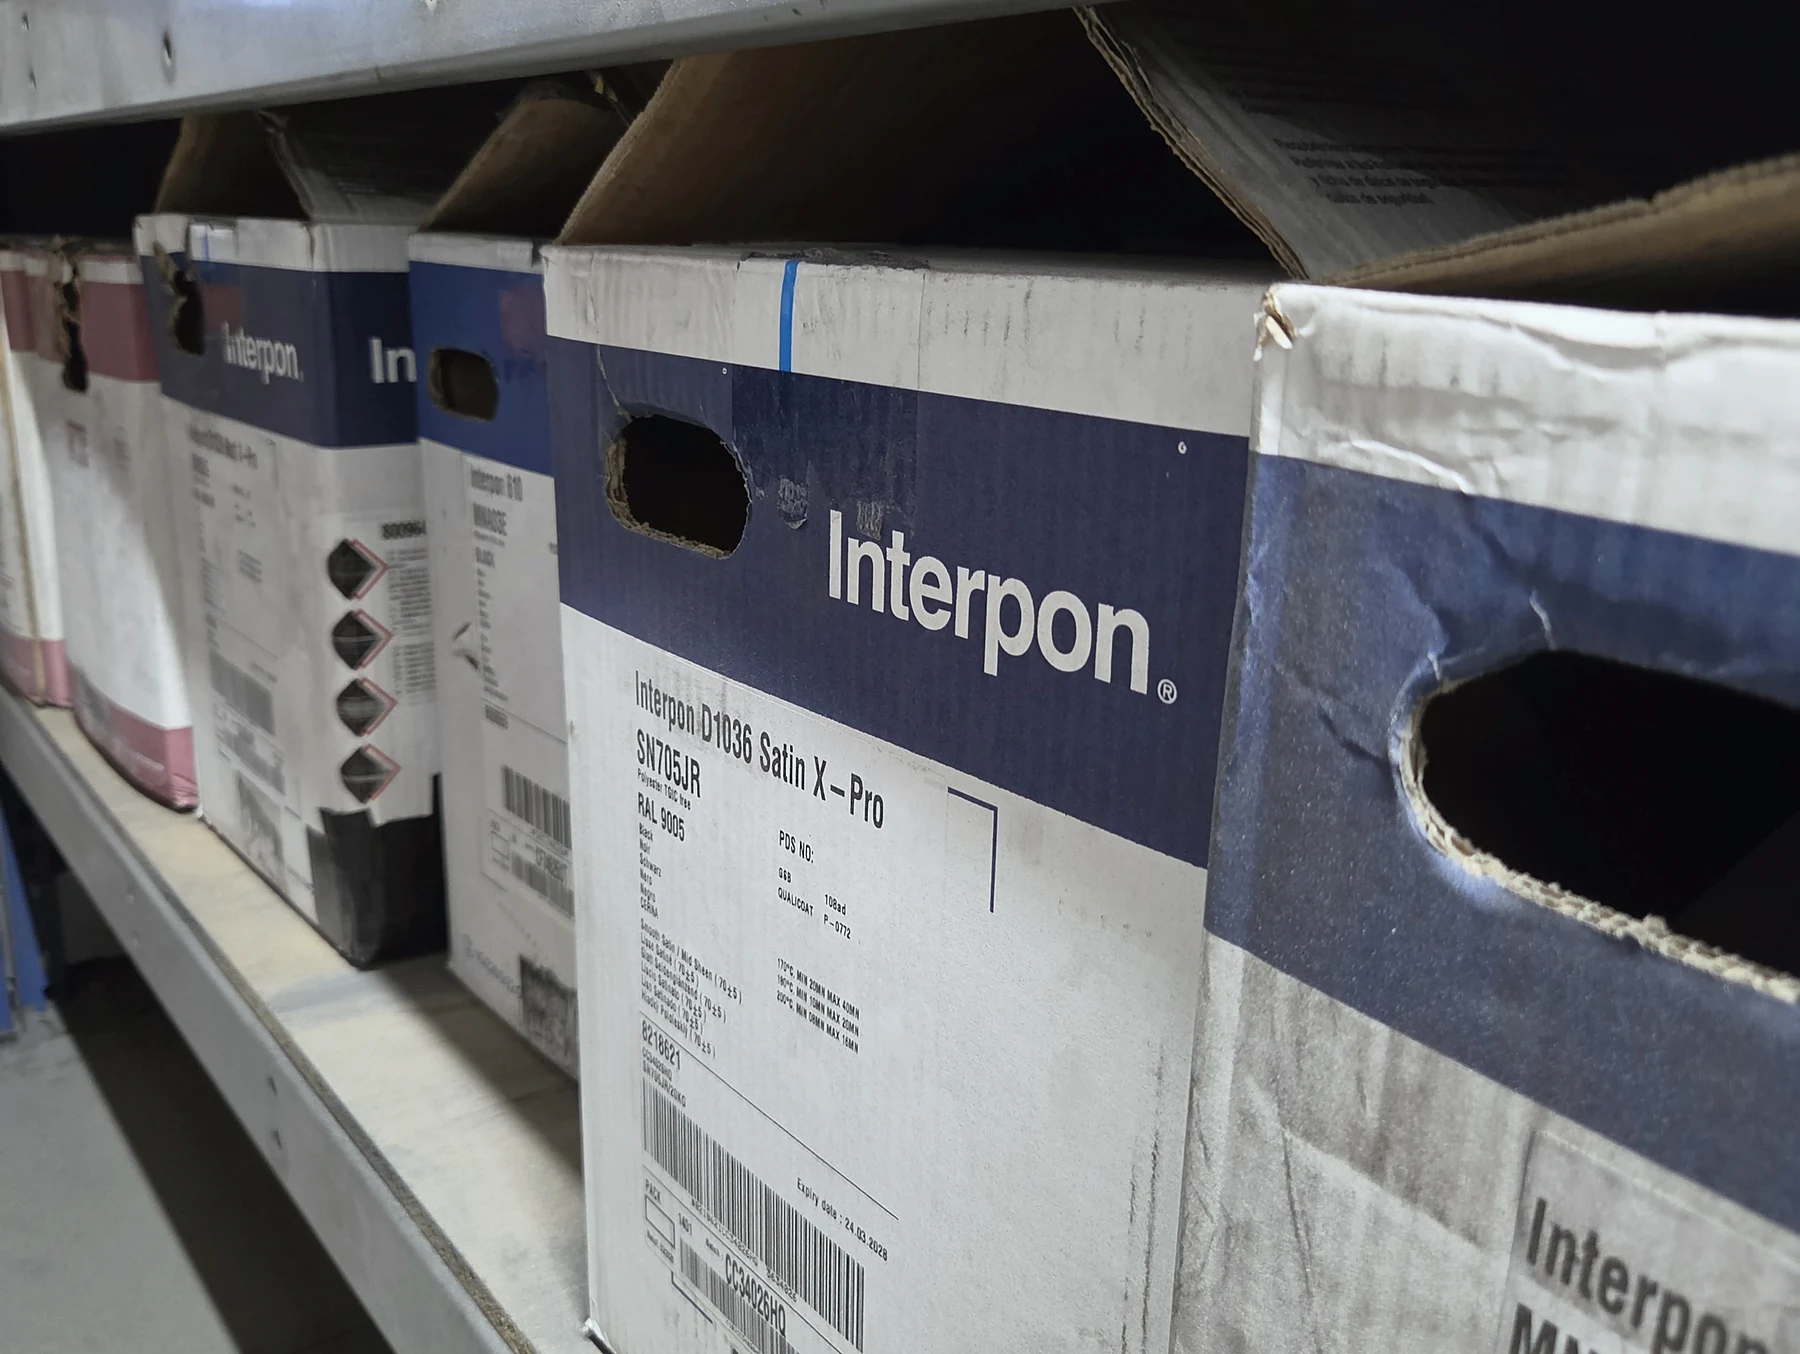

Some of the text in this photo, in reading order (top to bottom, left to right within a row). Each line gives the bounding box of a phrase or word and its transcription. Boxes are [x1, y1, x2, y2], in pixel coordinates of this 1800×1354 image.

[223, 321, 299, 384] Interpon
[828, 509, 1149, 695] Interpon
[635, 670, 694, 735] Interpon
[702, 703, 752, 764] D1036
[760, 731, 806, 791] Satin
[637, 729, 701, 798] SN705JR
[637, 768, 662, 793] Polyester
[680, 793, 691, 810] free
[638, 791, 685, 842] RAL 9005
[639, 852, 662, 877] Schwarz
[779, 829, 814, 863] PDS NO:
[640, 867, 652, 885] Nero
[640, 882, 656, 902] Negro
[778, 887, 814, 917] QUALICOAT
[824, 893, 847, 915] 108ad
[641, 917, 660, 941] Smooth
[661, 933, 675, 953] Satin
[681, 948, 692, 966] Mid
[694, 958, 712, 981] Sheen
[796, 986, 807, 1003] MIN
[826, 1007, 840, 1024] MAX
[797, 969, 808, 986] MIN
[827, 990, 841, 1008] MAX
[796, 1002, 807, 1020] MIN
[826, 1023, 840, 1041] MAX
[642, 1019, 680, 1071] 8218621
[797, 1177, 820, 1208] Expiry
[821, 1193, 837, 1220] date
[844, 1217, 888, 1261] 24.03.2028
[724, 1253, 787, 1338] CC34026HQ
